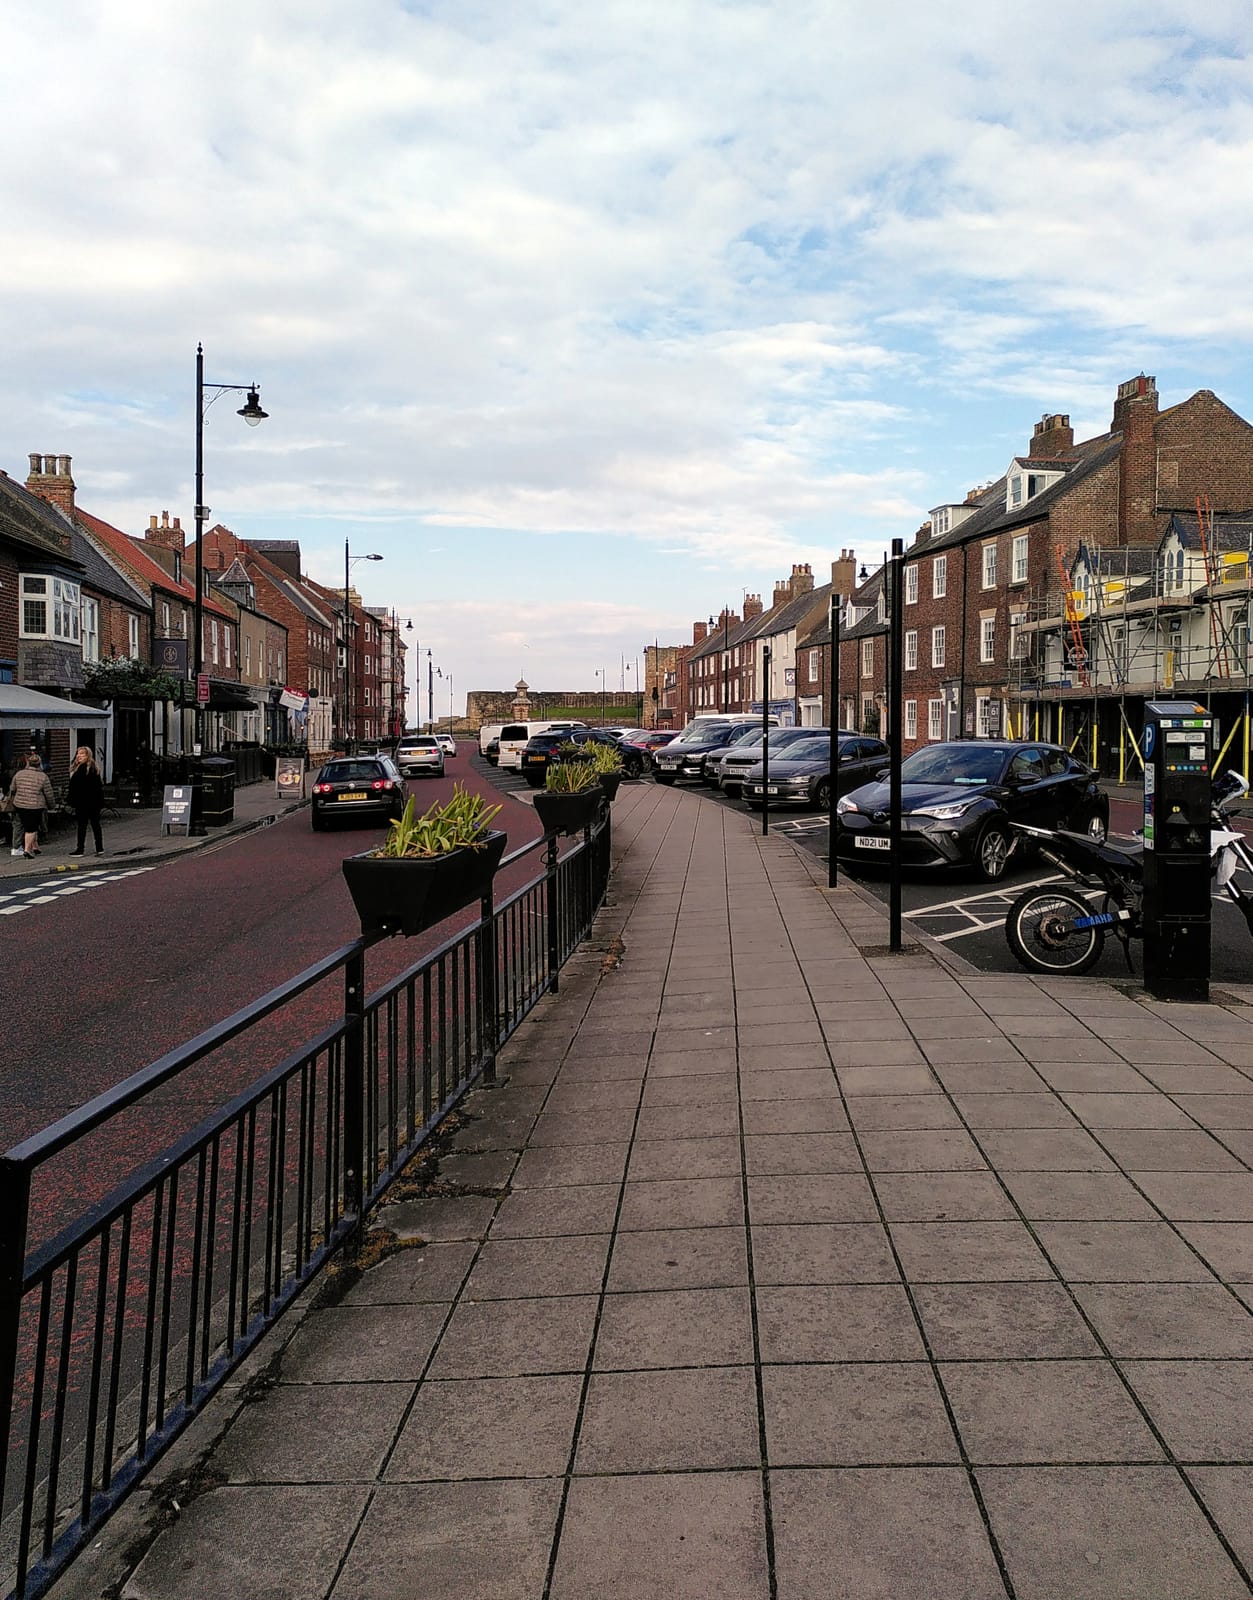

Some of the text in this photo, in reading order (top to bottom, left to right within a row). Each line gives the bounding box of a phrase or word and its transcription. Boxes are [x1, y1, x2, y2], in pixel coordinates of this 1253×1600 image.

[1145, 727, 1153, 752] P
[878, 839, 890, 848] UM
[1074, 913, 1113, 929] YAMAHA
